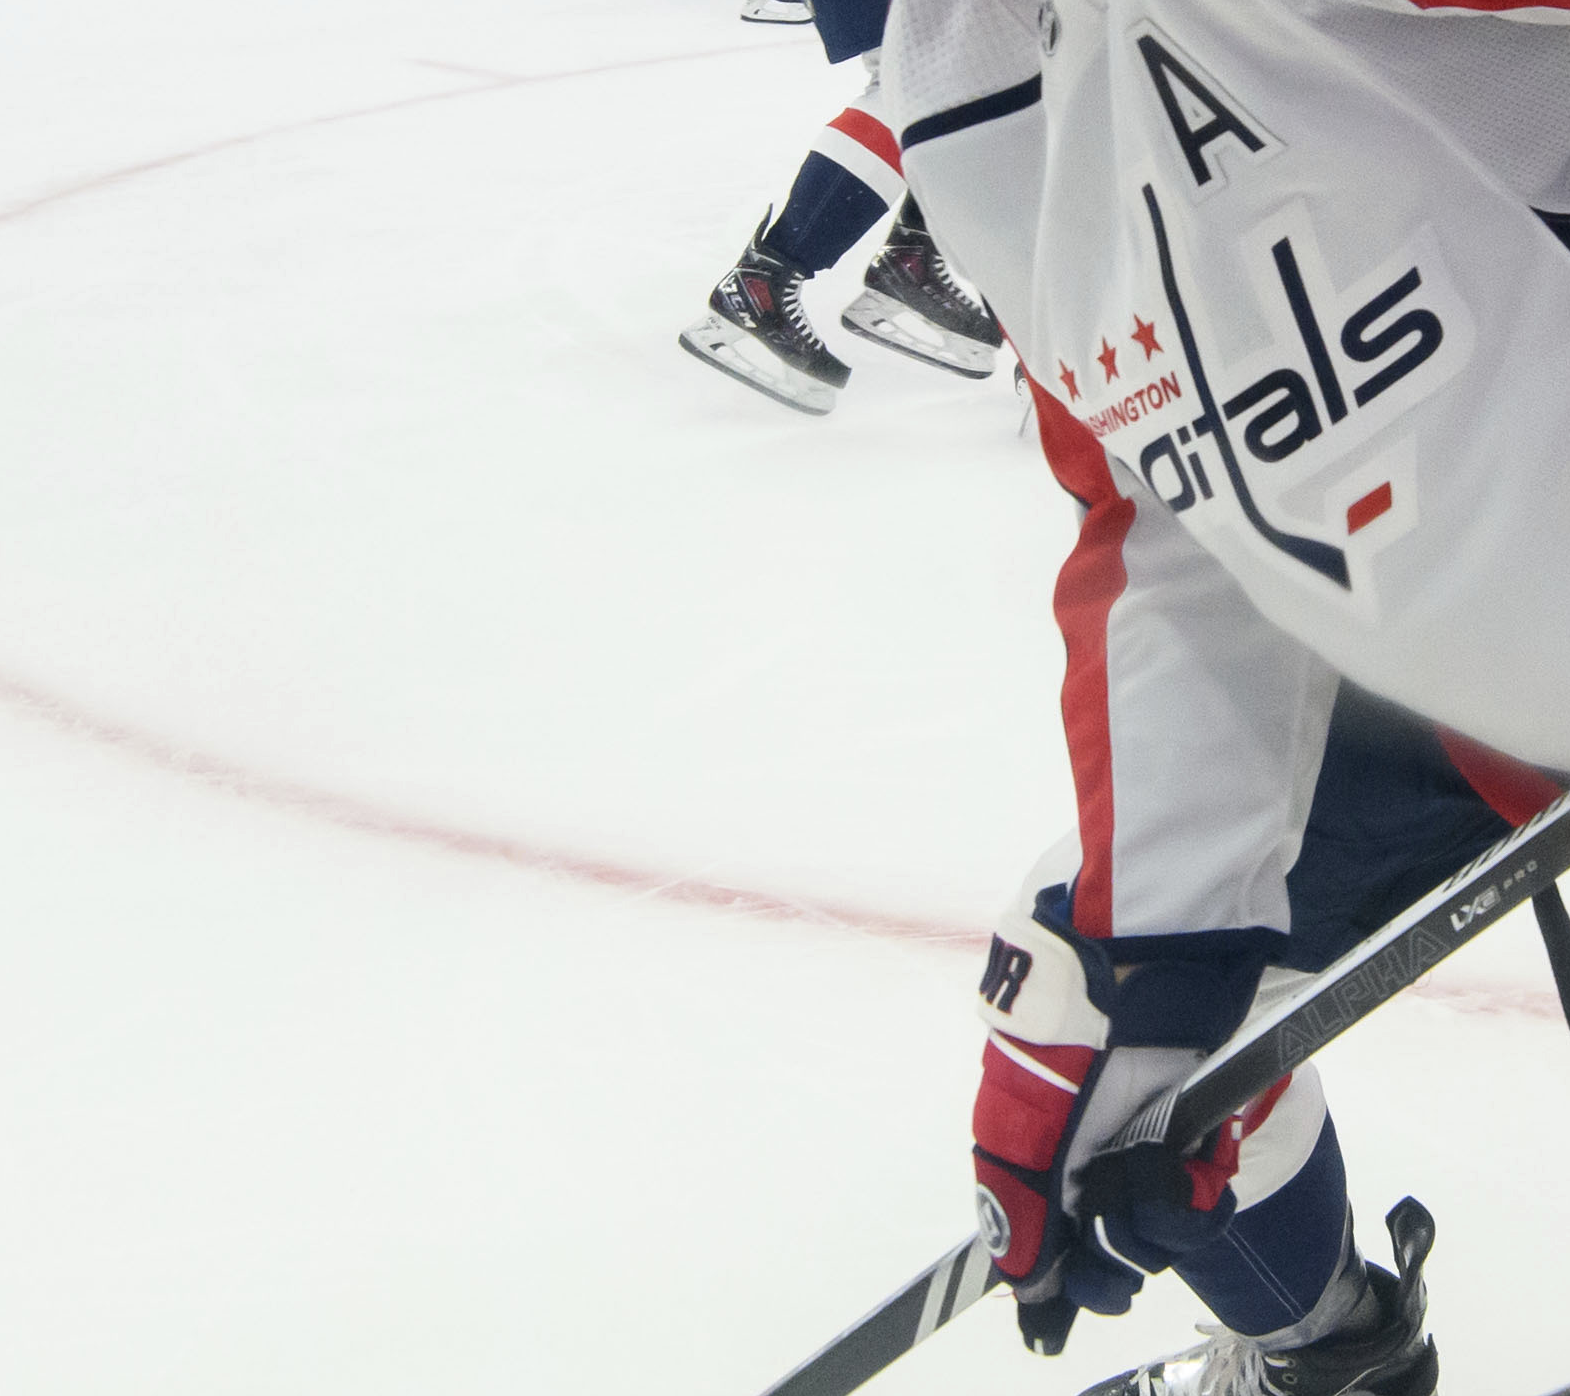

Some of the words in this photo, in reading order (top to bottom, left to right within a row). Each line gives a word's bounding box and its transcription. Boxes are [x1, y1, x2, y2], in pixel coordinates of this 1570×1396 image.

[1137, 33, 1266, 187] A
[1087, 370, 1182, 437] SHINGTON
[1137, 180, 1444, 591] pitals
[1278, 925, 1451, 1071] ALPHA
